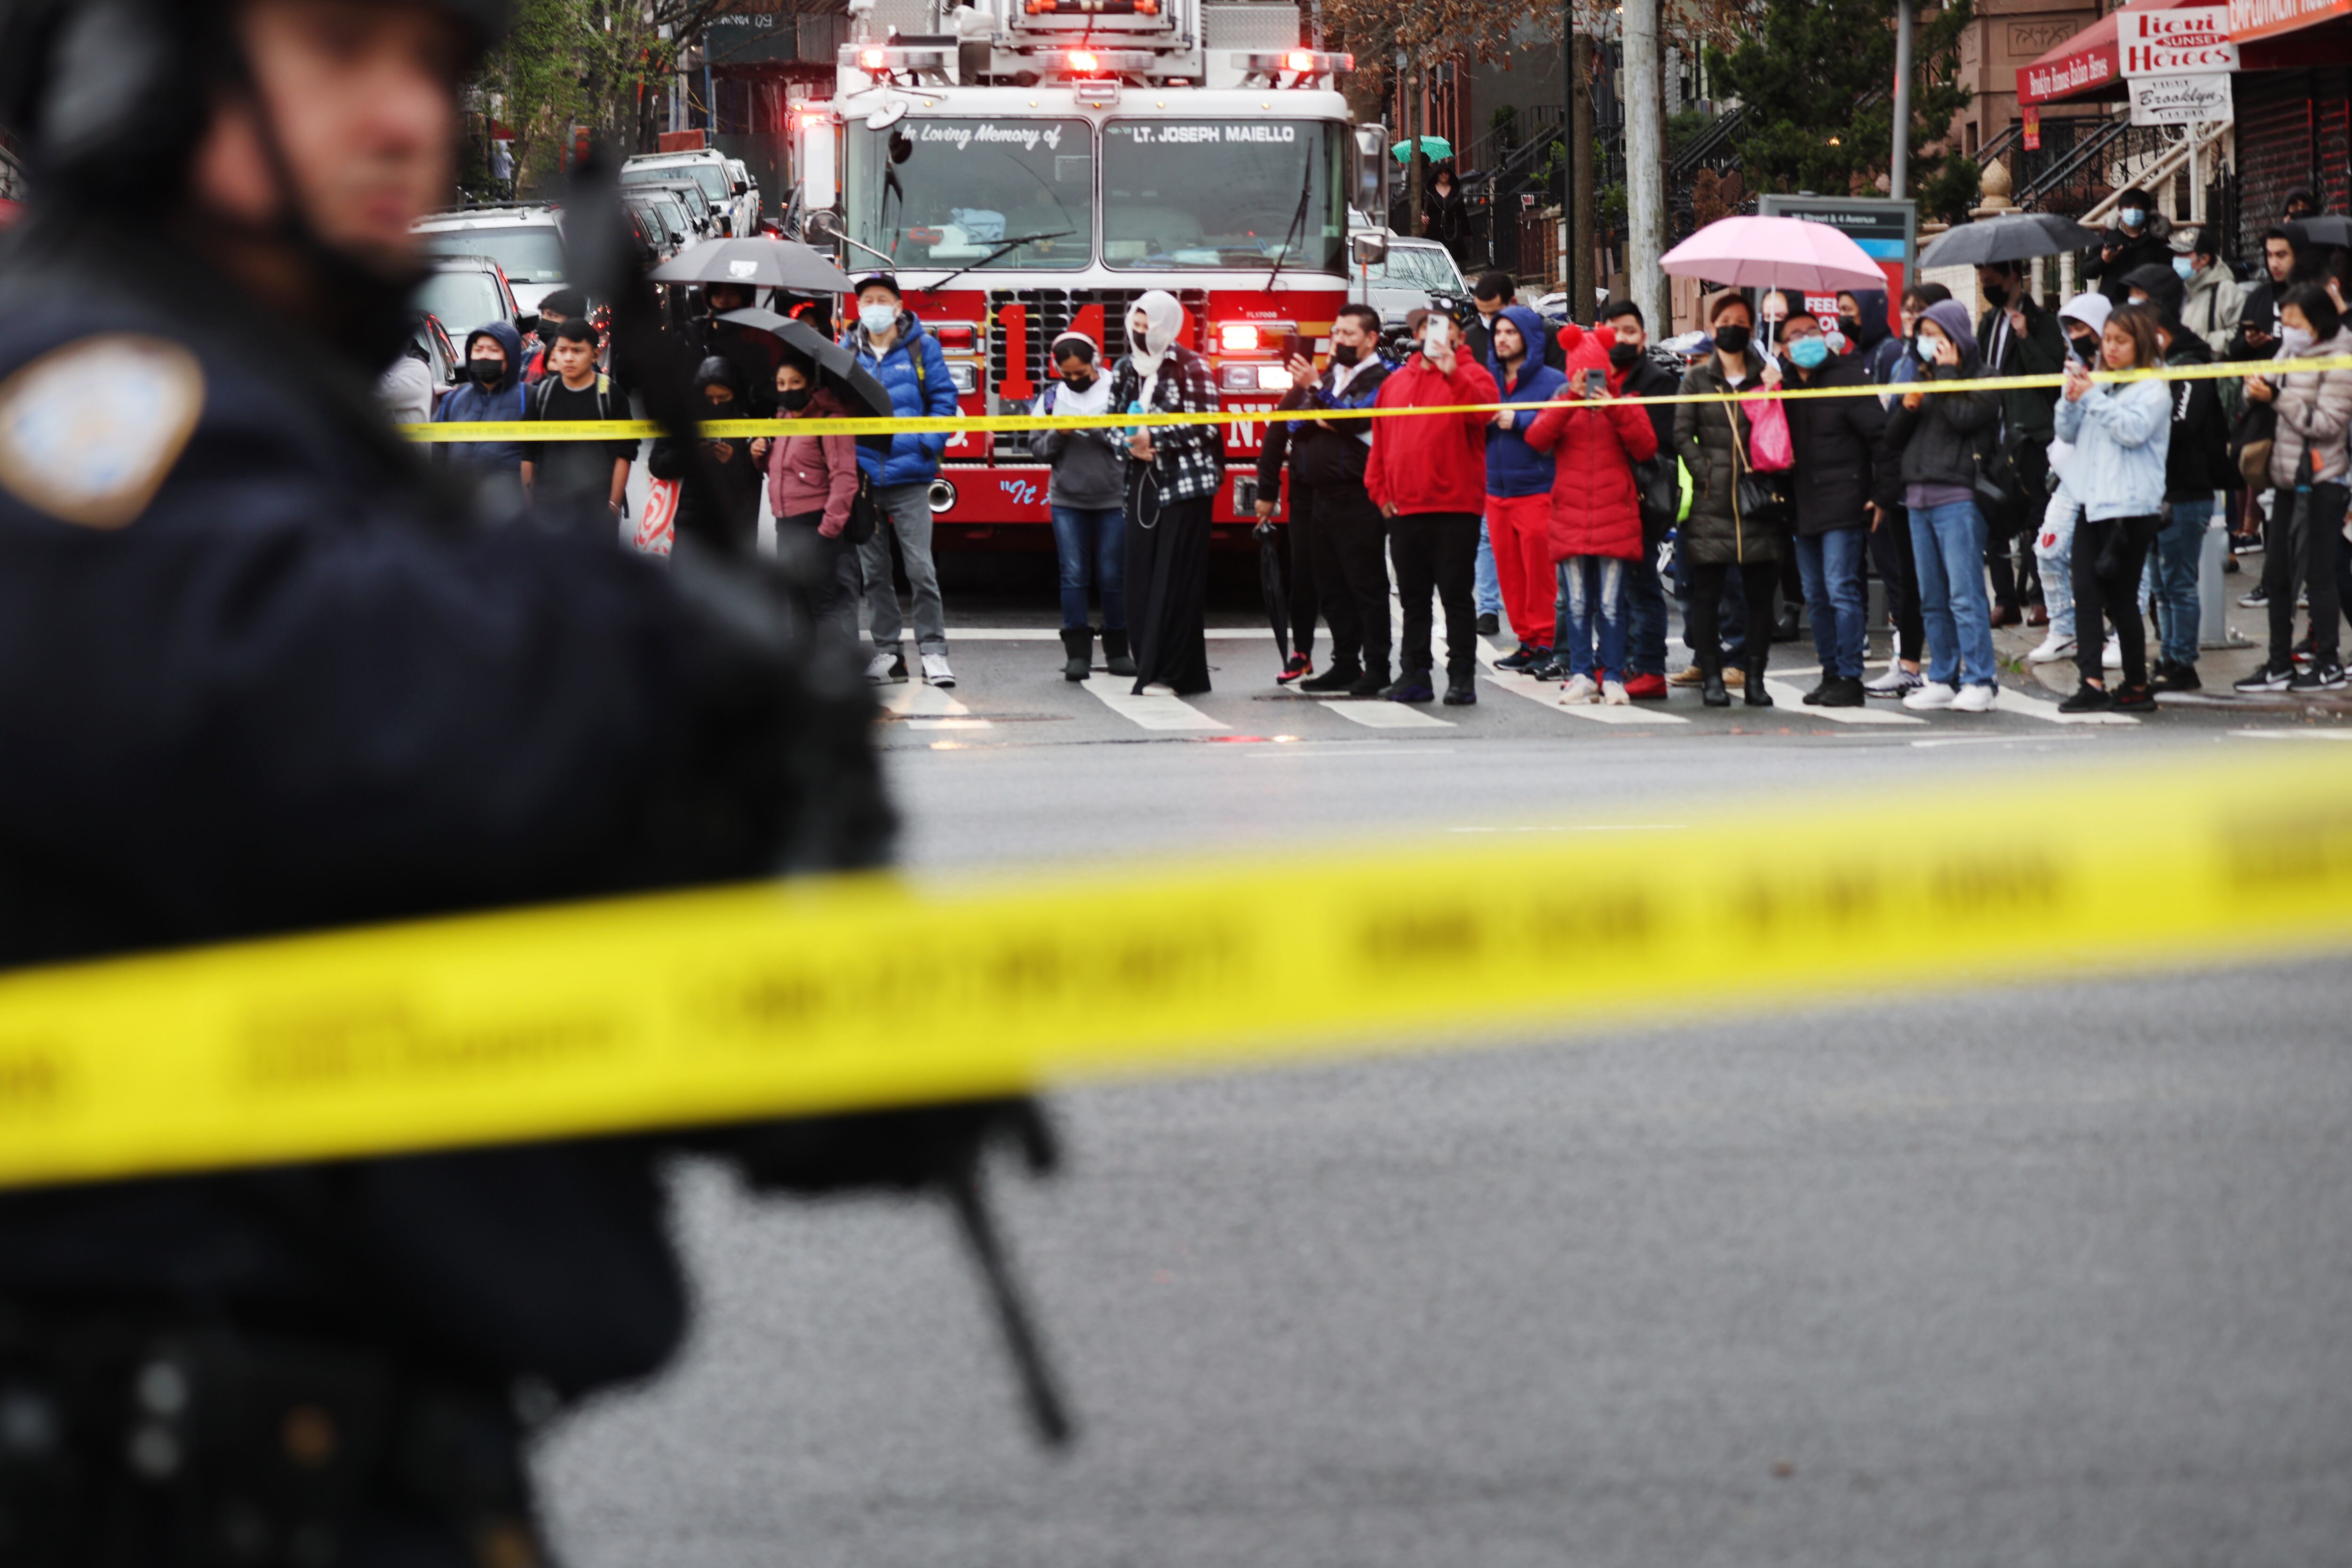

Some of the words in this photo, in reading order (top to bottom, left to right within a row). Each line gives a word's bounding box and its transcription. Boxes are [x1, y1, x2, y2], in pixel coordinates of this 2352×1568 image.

[2163, 34, 2220, 47] SUNSET
[901, 123, 917, 140] In
[920, 124, 971, 150] Loving
[974, 124, 1040, 151] Memory
[1043, 124, 1061, 150] of
[1134, 127, 1155, 143] LT.
[1158, 126, 1220, 143] JOSEPH
[1225, 126, 1295, 142] MAIELLO
[1804, 297, 1840, 312] FEEL
